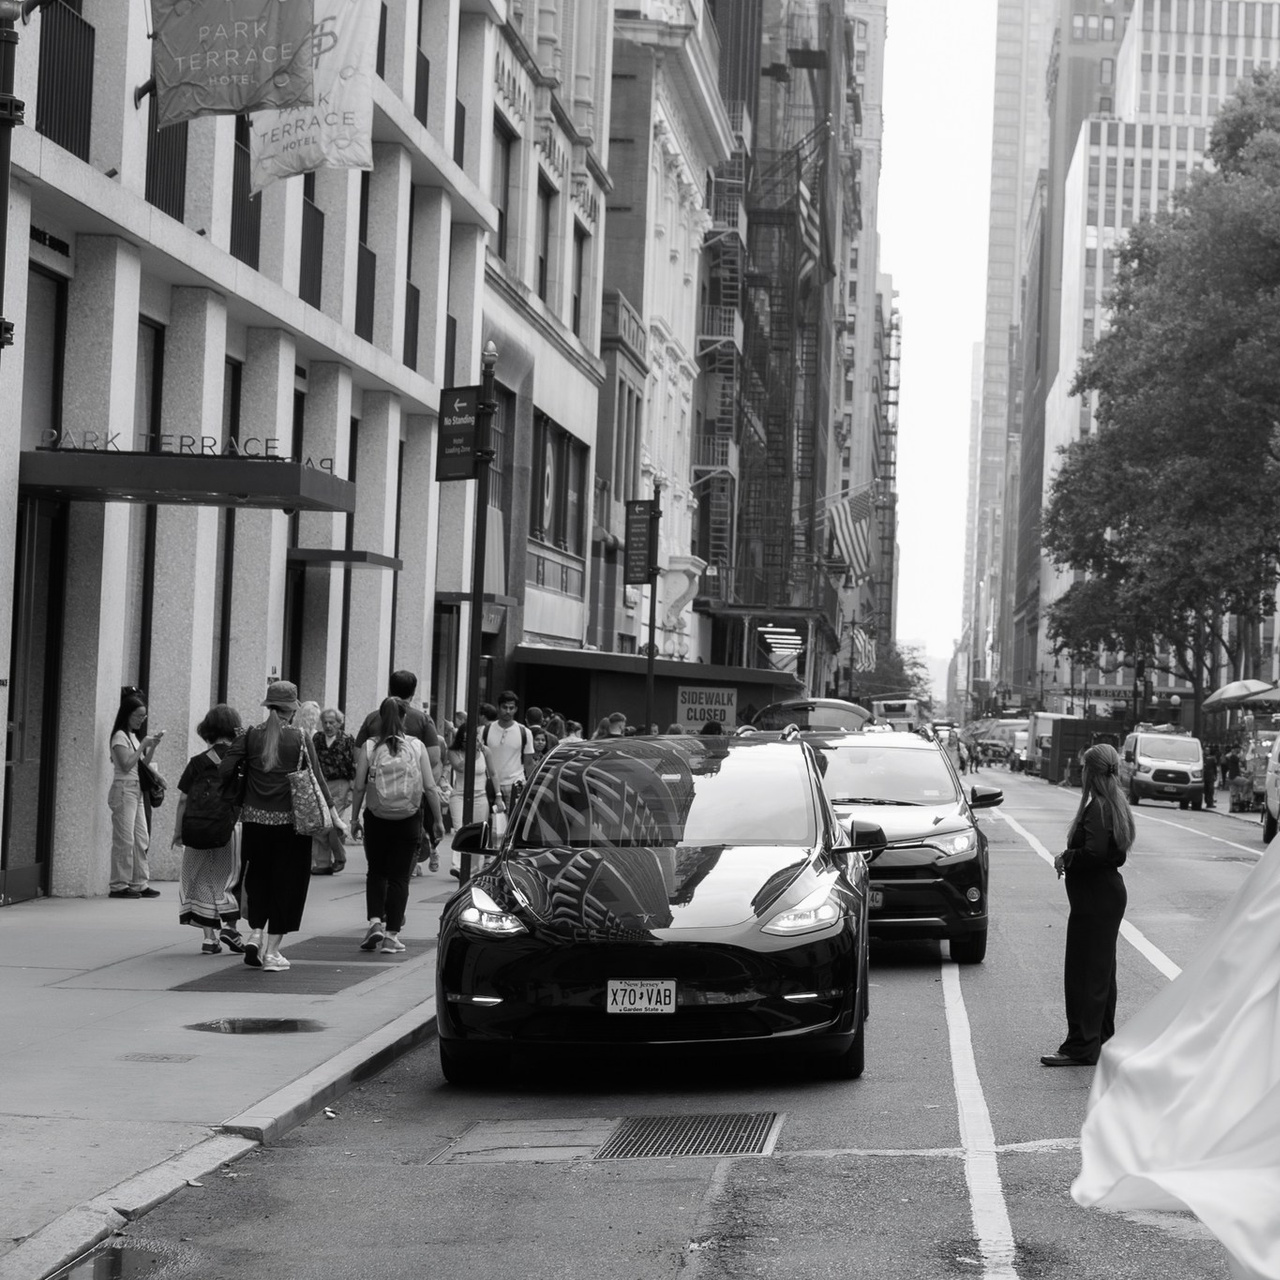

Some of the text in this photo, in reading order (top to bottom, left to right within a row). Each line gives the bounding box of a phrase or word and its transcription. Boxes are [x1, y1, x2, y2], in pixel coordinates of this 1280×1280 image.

[199, 21, 267, 41] PARK
[174, 42, 293, 72] TERRACE
[208, 74, 258, 86] HOTEL
[260, 111, 355, 146] TERRACE
[282, 136, 317, 153] HOTEL
[443, 414, 475, 426] No Standing
[40, 428, 280, 458] PARK TERRACE
[680, 690, 734, 707] SIDEWALK
[686, 707, 727, 722] CLOSED
[611, 988, 672, 1006] X70 VAB
